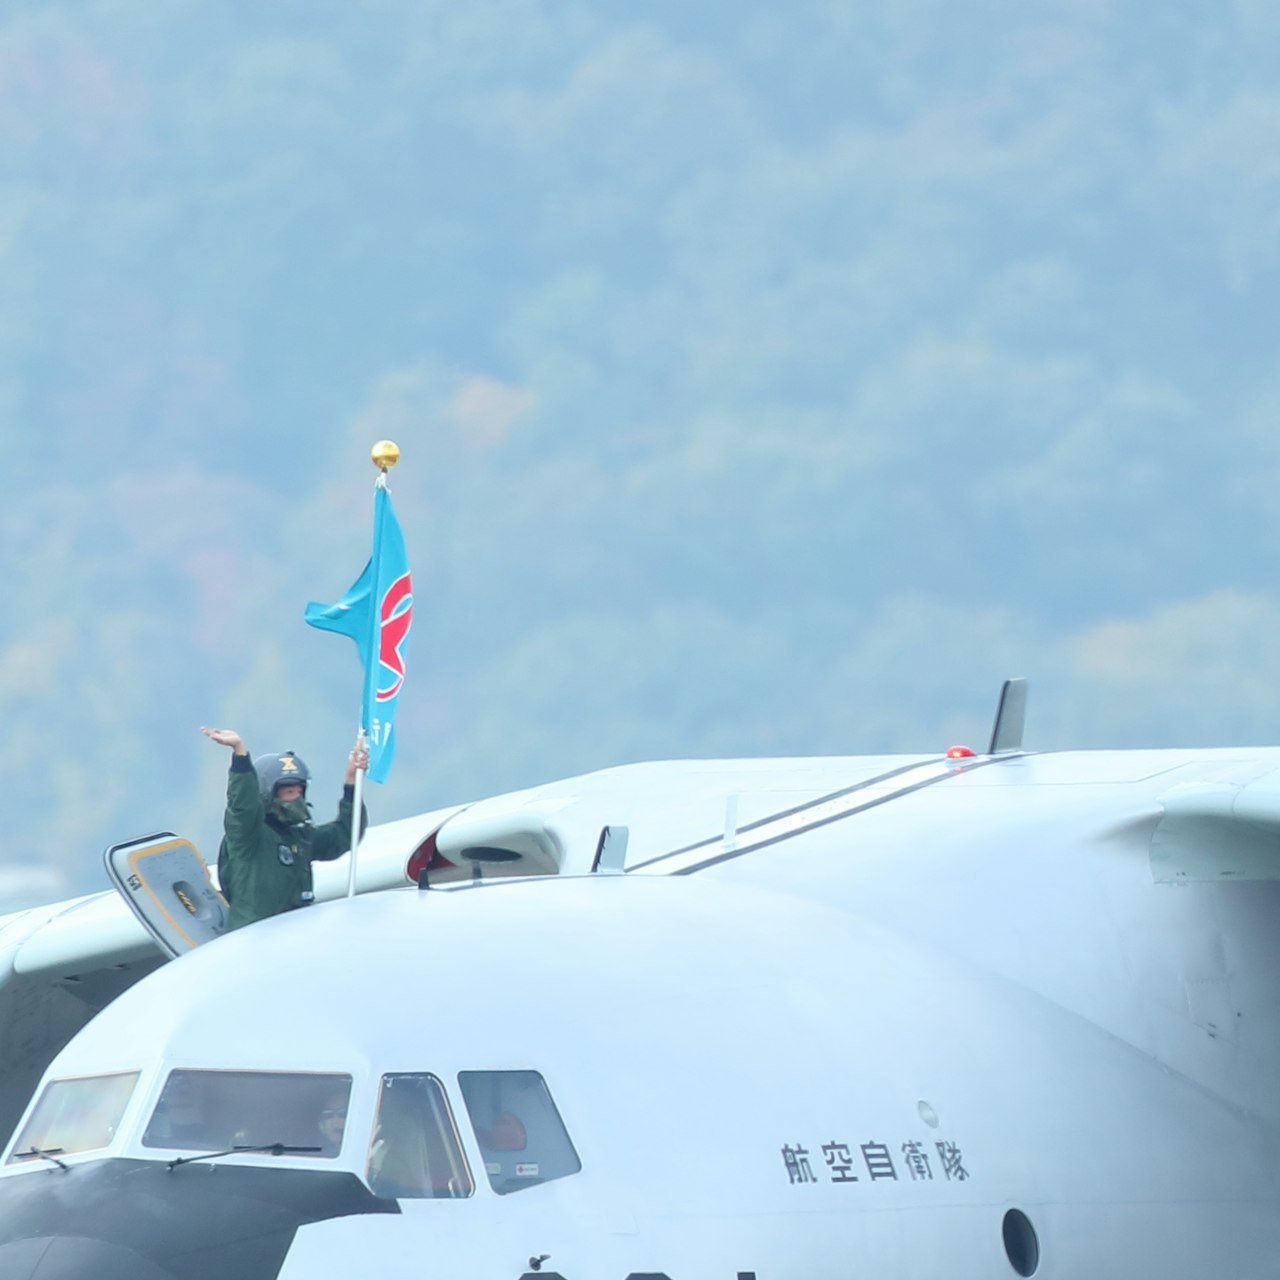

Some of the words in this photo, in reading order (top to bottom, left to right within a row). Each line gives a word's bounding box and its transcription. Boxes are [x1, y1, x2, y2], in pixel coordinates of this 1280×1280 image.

[780, 1139, 970, 1185] 航空自衛隊
